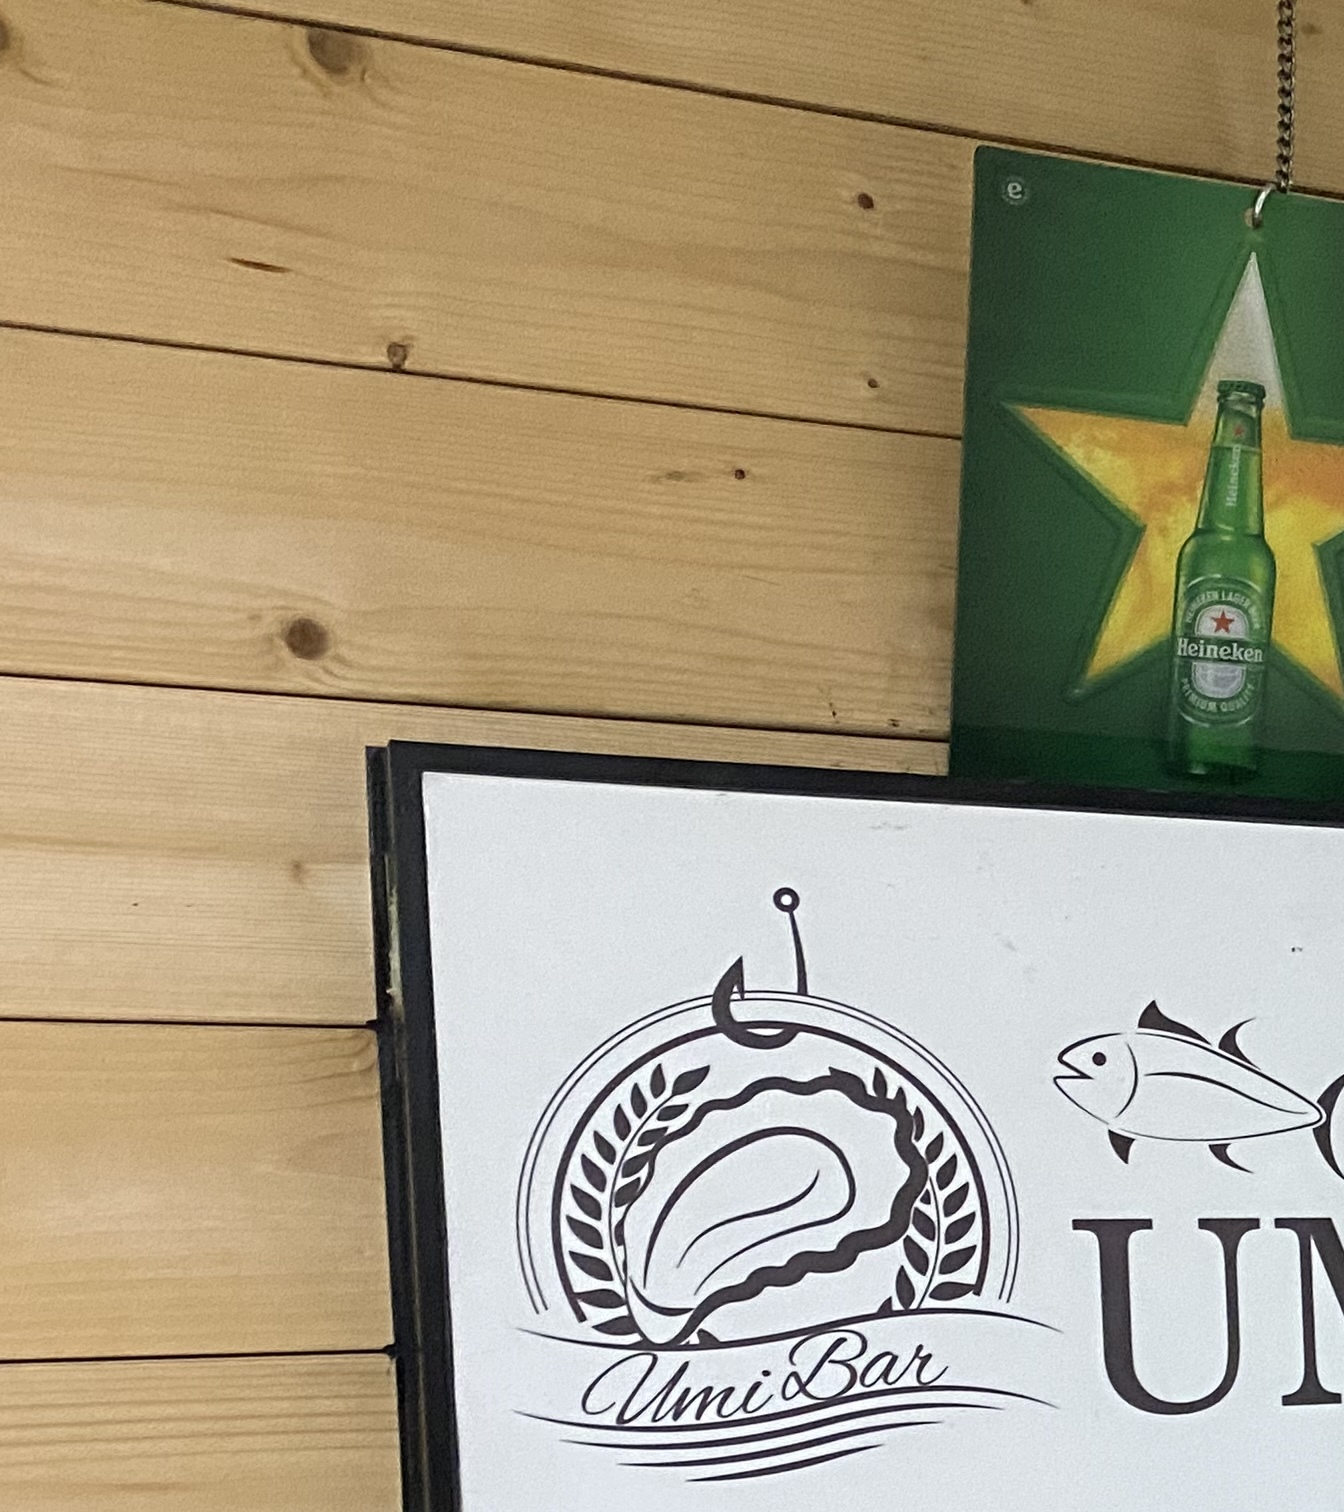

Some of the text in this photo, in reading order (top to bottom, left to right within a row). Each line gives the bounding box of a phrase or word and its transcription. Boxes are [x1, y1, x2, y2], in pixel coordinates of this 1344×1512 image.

[1178, 638, 1263, 662] Heineken
[581, 1328, 951, 1424] Umi Bar
